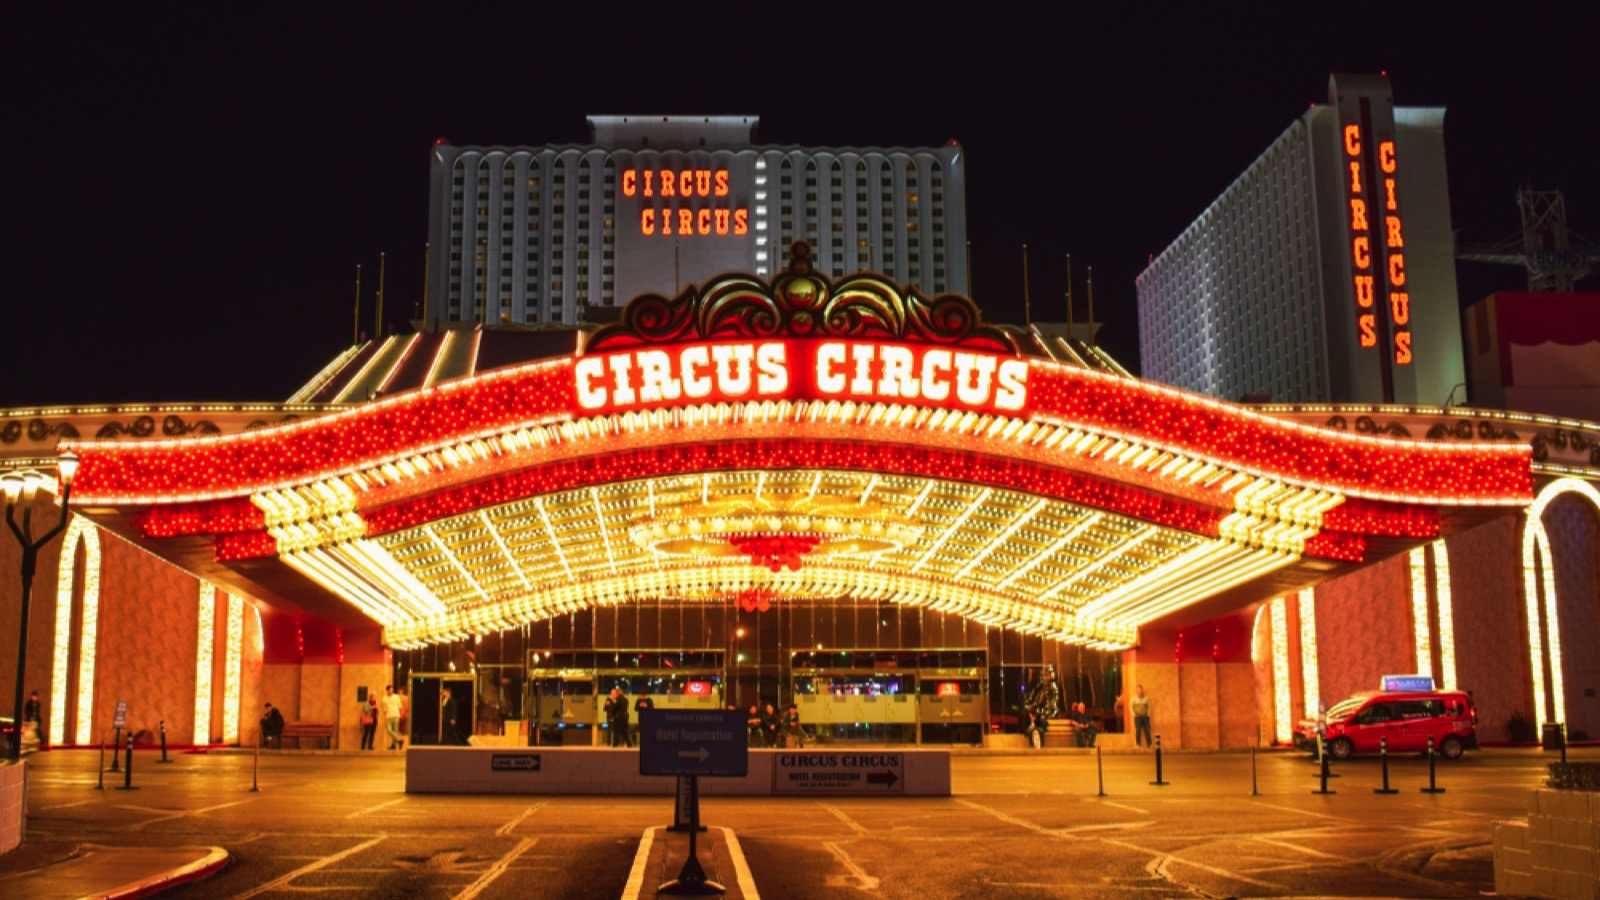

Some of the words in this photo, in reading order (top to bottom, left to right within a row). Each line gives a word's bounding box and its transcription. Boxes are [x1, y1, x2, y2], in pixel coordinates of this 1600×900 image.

[622, 169, 729, 197] CIRCUS
[641, 208, 748, 236] CIRCUS
[1344, 124, 1377, 347] CIRCUS
[1379, 141, 1412, 365] CIRCUS
[575, 342, 788, 409] CIRCUS
[816, 341, 1029, 410] CIRCUS
[655, 728, 679, 741] Hotel
[680, 728, 733, 743] Registration
[495, 759, 511, 767] ONE
[514, 759, 532, 767] WAY
[781, 755, 838, 767] CIRCUS
[841, 755, 899, 767] CIRCUS
[788, 772, 809, 781] HOTEL
[812, 772, 860, 781] REGISTRATION
